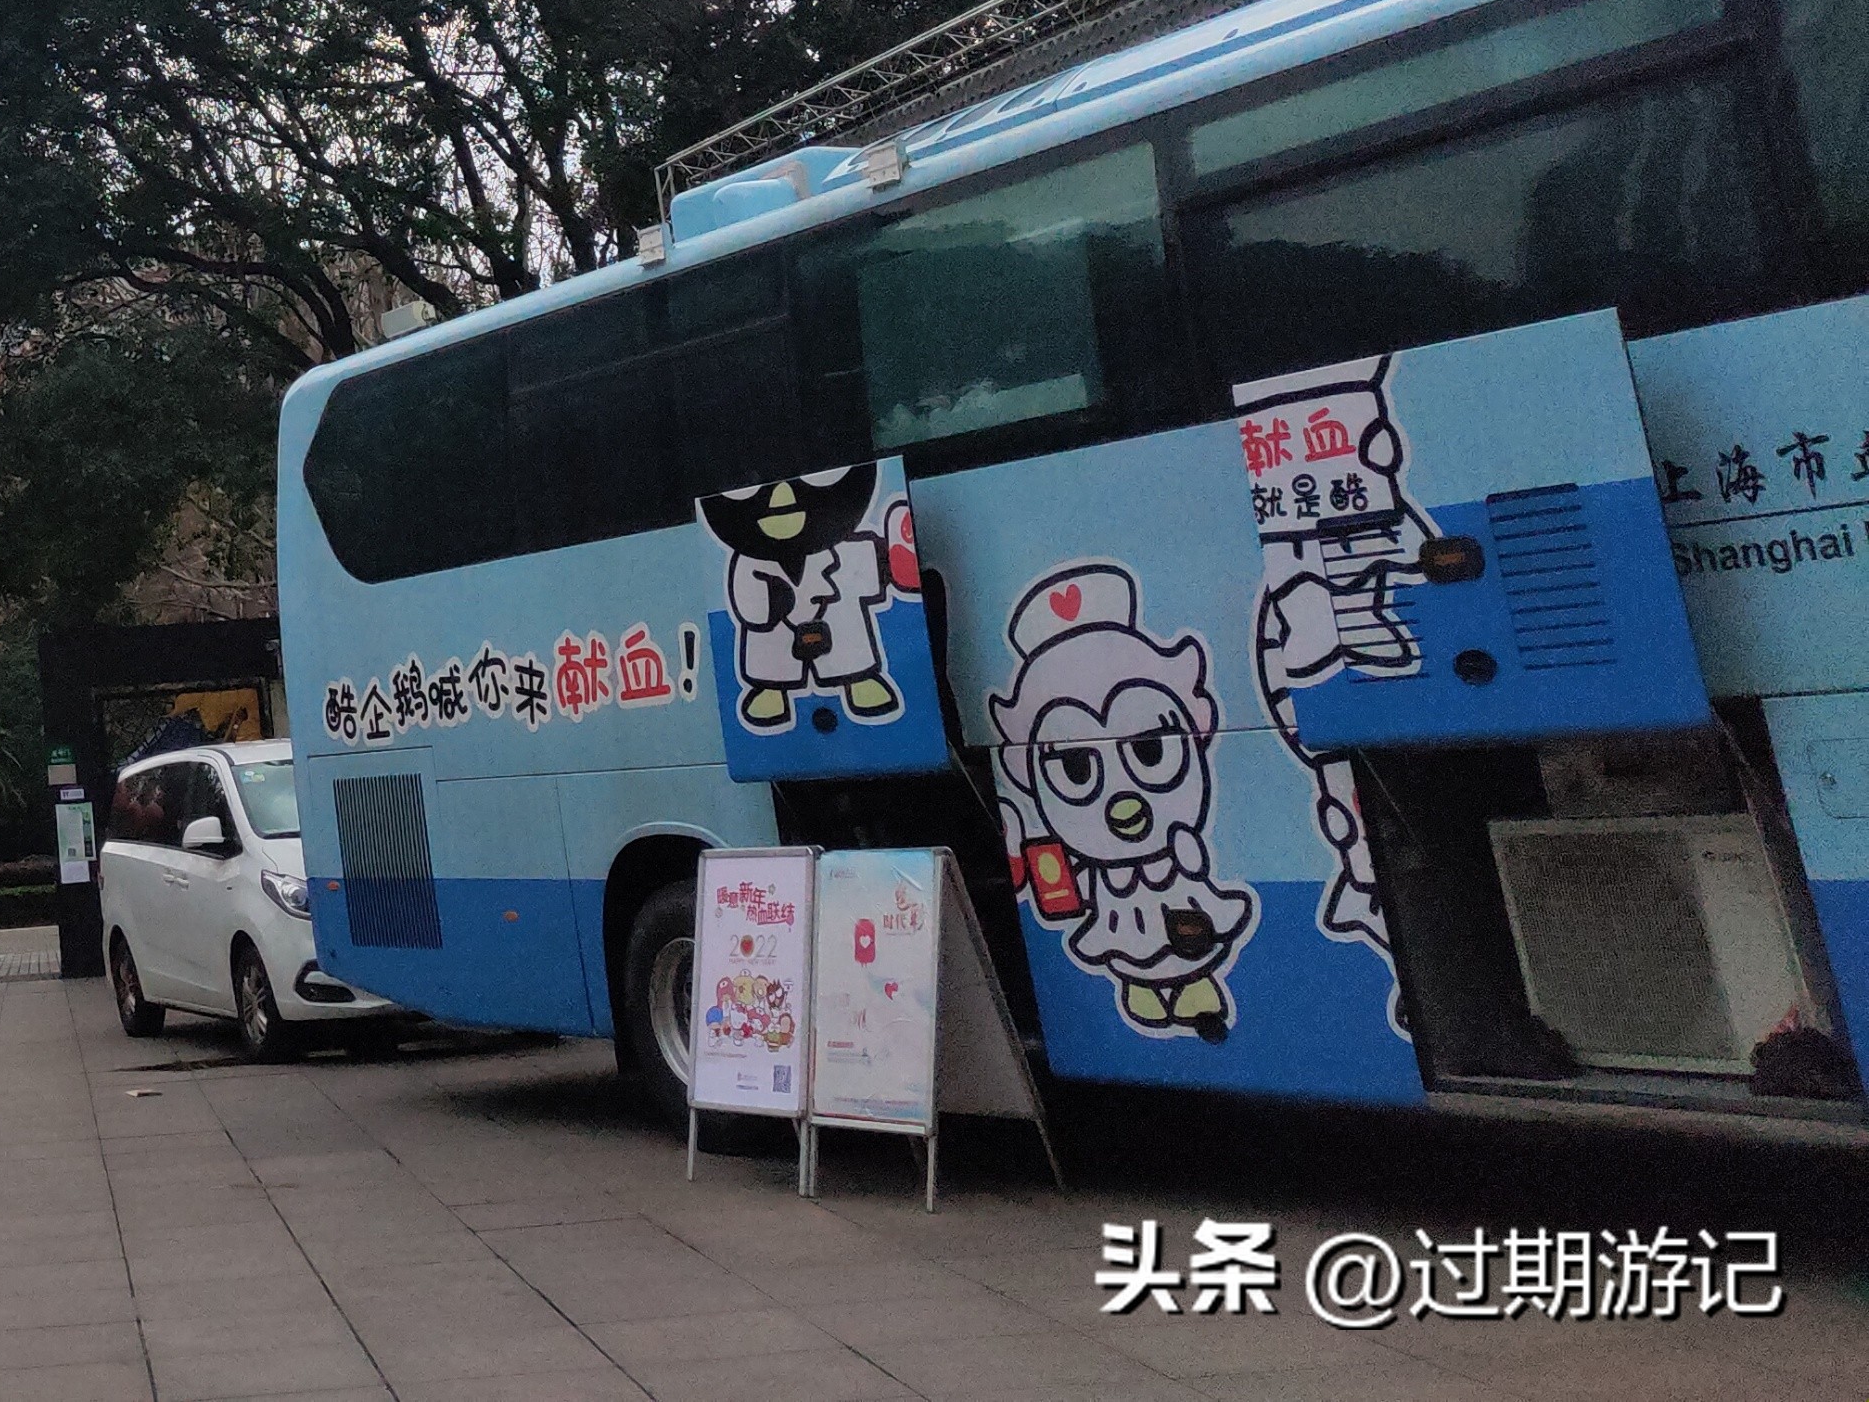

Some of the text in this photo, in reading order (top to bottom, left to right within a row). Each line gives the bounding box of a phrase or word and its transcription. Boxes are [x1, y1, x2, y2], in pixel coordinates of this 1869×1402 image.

[1240, 407, 1356, 477] 献血
[1251, 472, 1369, 525] 就是酷
